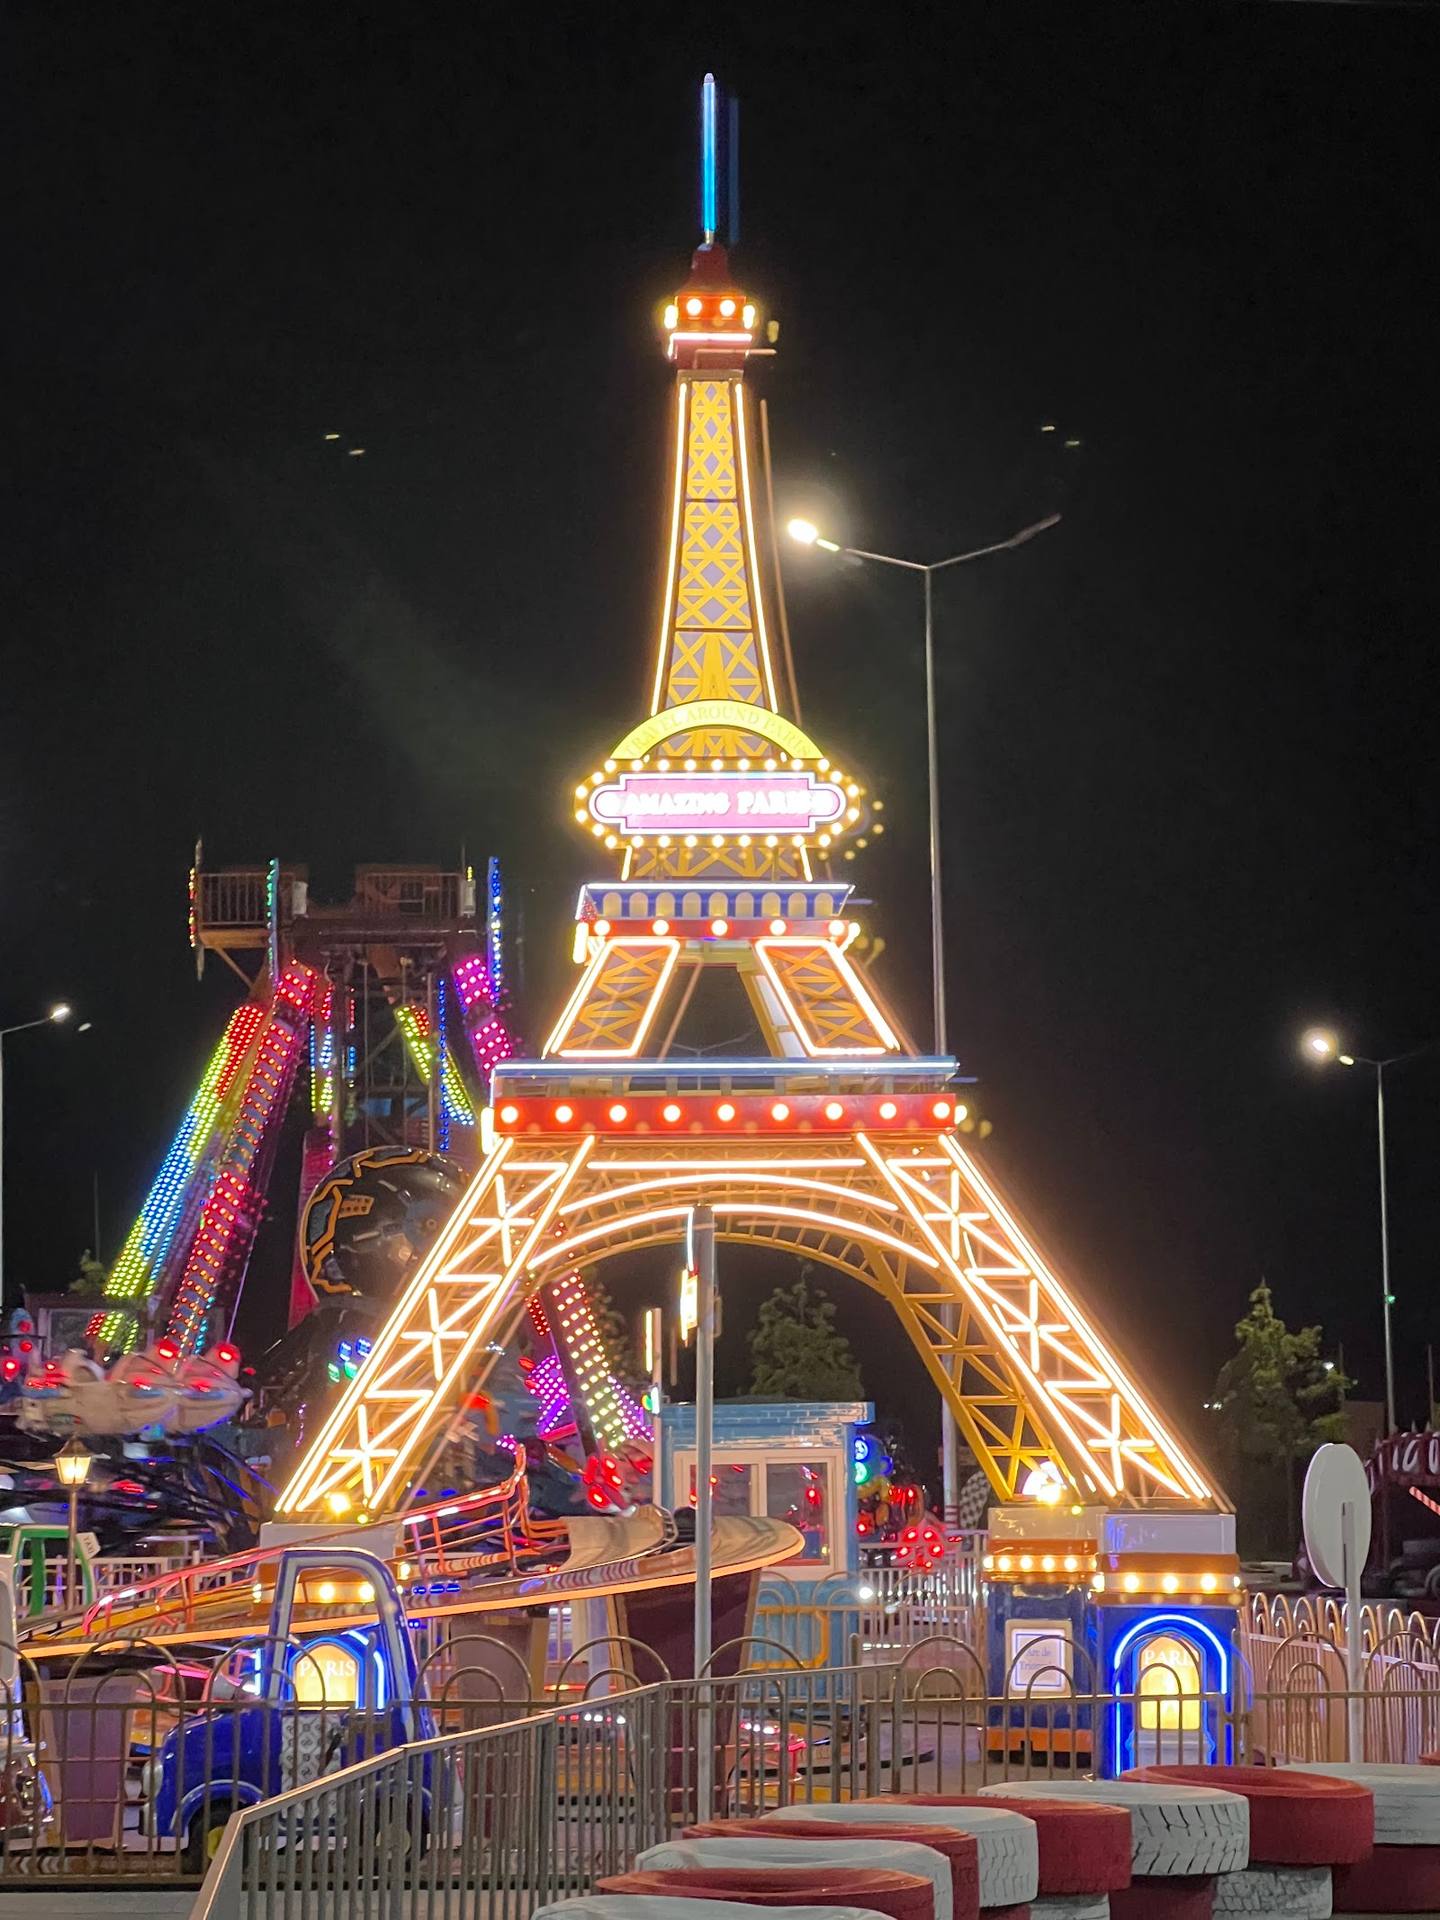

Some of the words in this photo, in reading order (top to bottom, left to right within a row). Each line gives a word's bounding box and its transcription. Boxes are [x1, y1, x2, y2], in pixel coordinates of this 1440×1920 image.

[624, 709, 683, 756] TRAVEL
[686, 704, 760, 725] AROUND
[763, 716, 811, 757] PARIS
[622, 792, 730, 816] AMAZING
